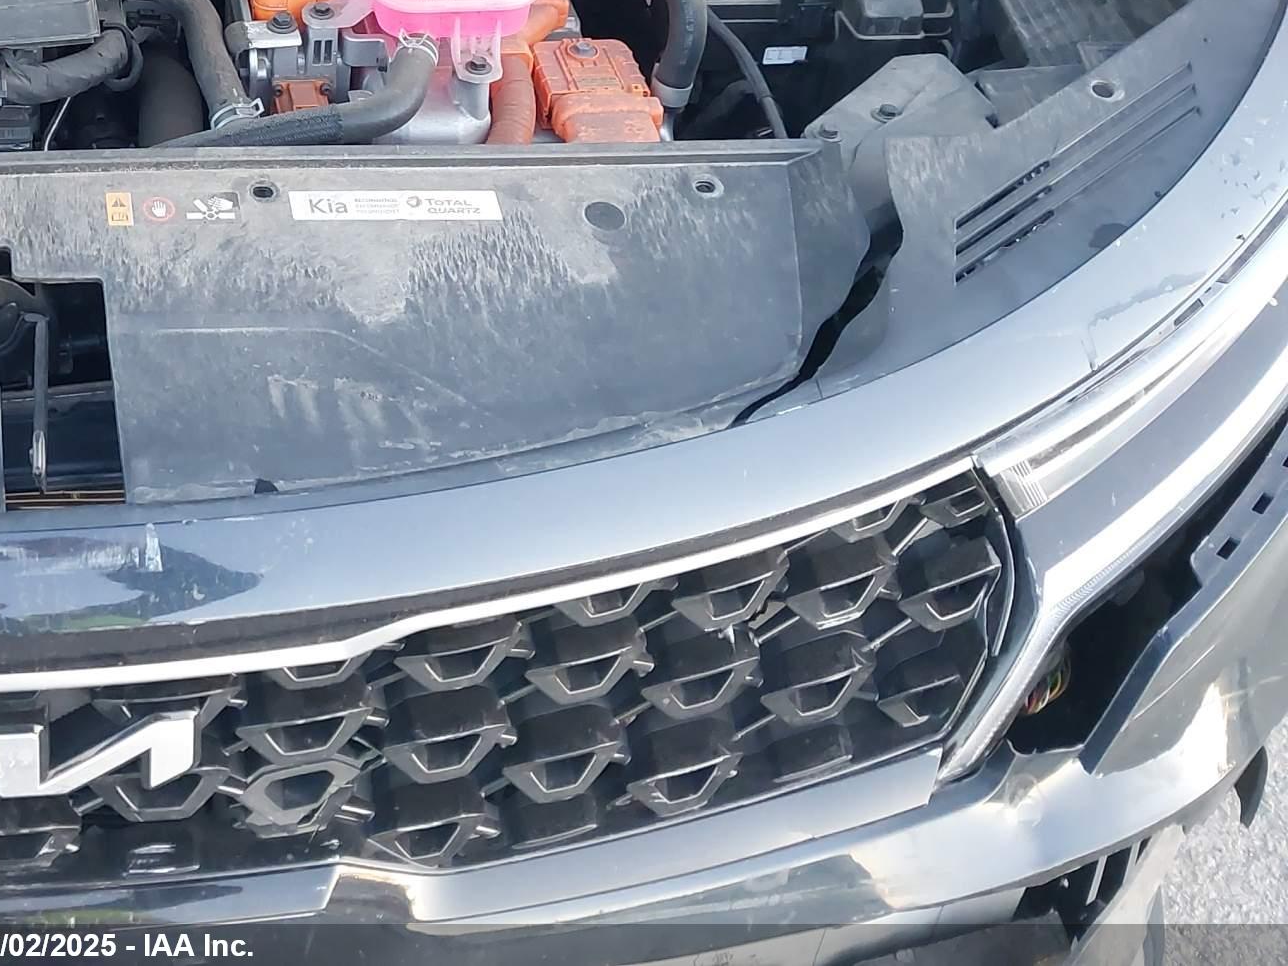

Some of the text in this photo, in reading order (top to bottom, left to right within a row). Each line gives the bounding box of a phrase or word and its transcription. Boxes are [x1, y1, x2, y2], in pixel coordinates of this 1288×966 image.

[308, 198, 348, 214] Kia
[424, 198, 472, 206] TOTAL
[427, 207, 481, 215] QUARTZ
